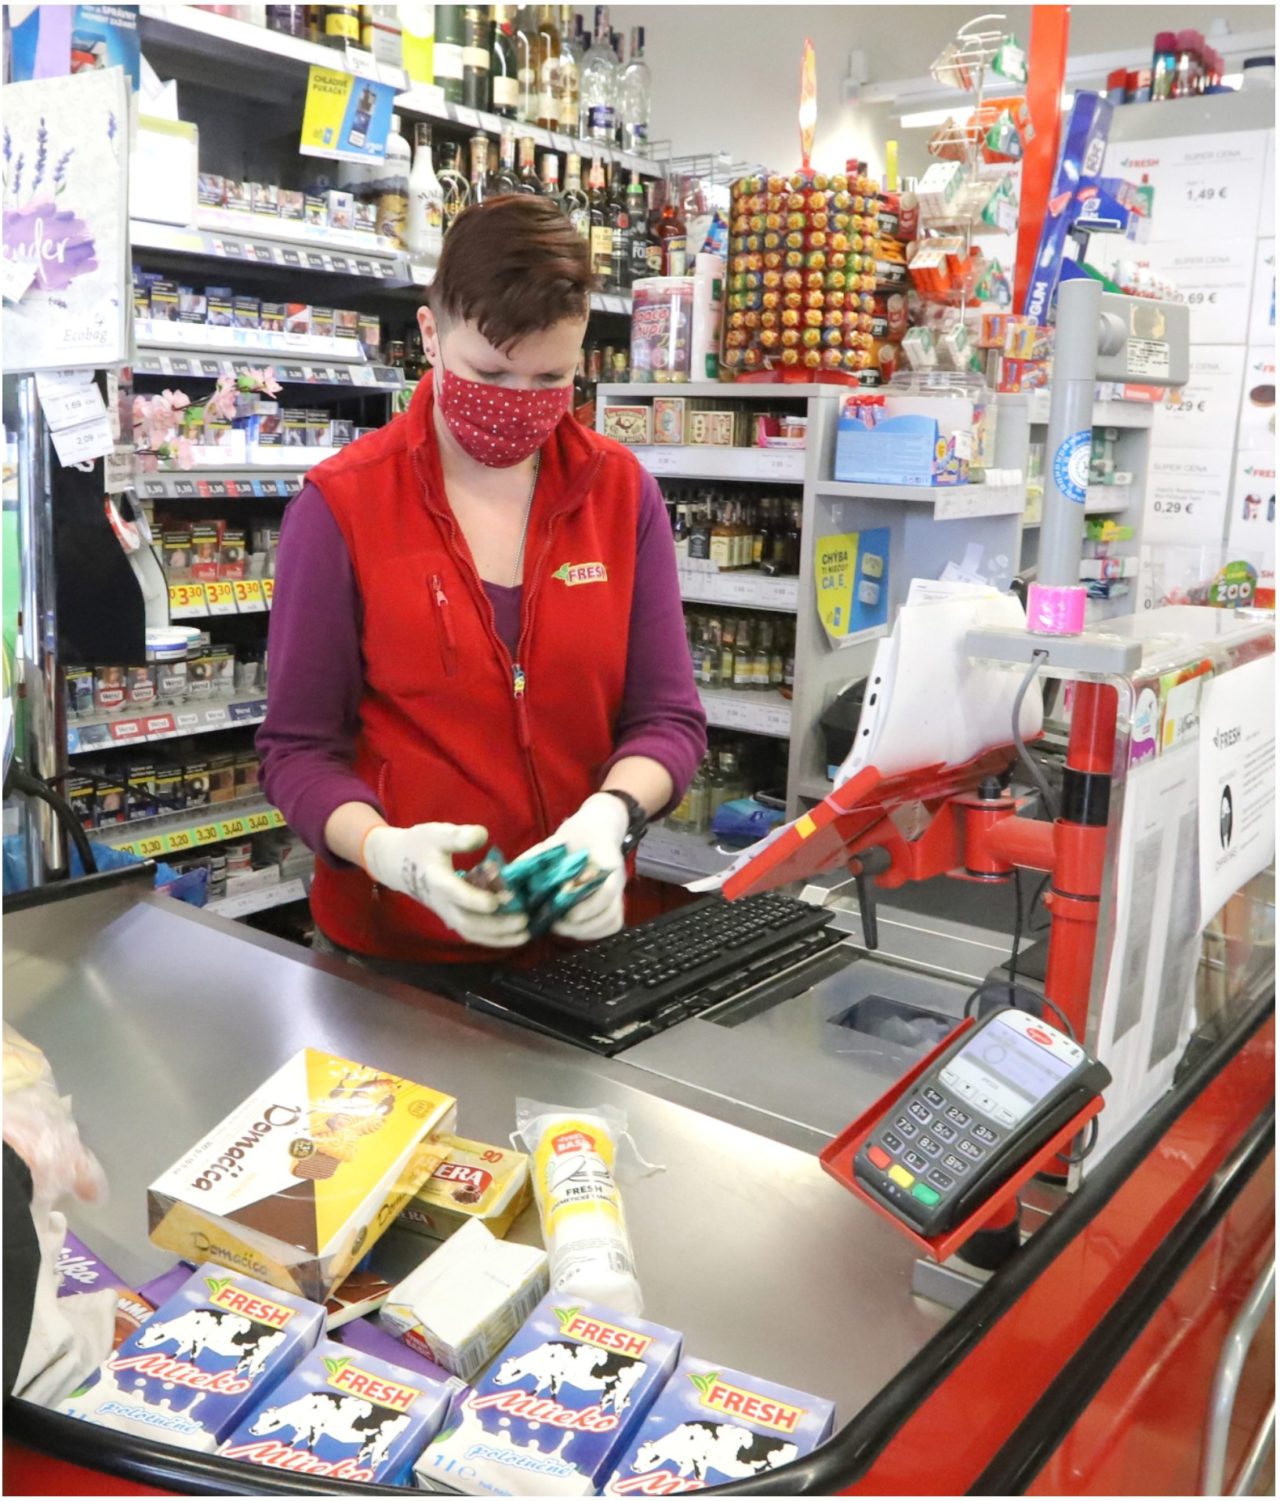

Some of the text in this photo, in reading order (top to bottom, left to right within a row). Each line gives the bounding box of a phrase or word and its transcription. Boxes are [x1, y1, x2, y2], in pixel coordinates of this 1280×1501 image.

[1185, 150, 1241, 161] SUPER CENA
[1128, 158, 1160, 168] FRESH
[1187, 187, 1228, 201] 1,49 €
[1174, 256, 1231, 265] SUPER CENA
[1209, 292, 1217, 303] €
[64, 327, 108, 343] Ecobag
[1197, 400, 1206, 412] €
[1153, 463, 1207, 472] SUPER CENA
[1154, 501, 1193, 513] 0,29 €
[1219, 725, 1242, 750] FRESH
[480, 1150, 503, 1163] 90
[566, 1185, 603, 1197] FRESH
[55, 1248, 100, 1284] ilka
[217, 1288, 291, 1326] FRESH
[568, 1318, 648, 1355] FRESH
[108, 1352, 252, 1395] Mlieko
[335, 1369, 417, 1409] FRESH
[468, 1389, 620, 1432] Mlieko
[708, 1384, 799, 1430] FRESH
